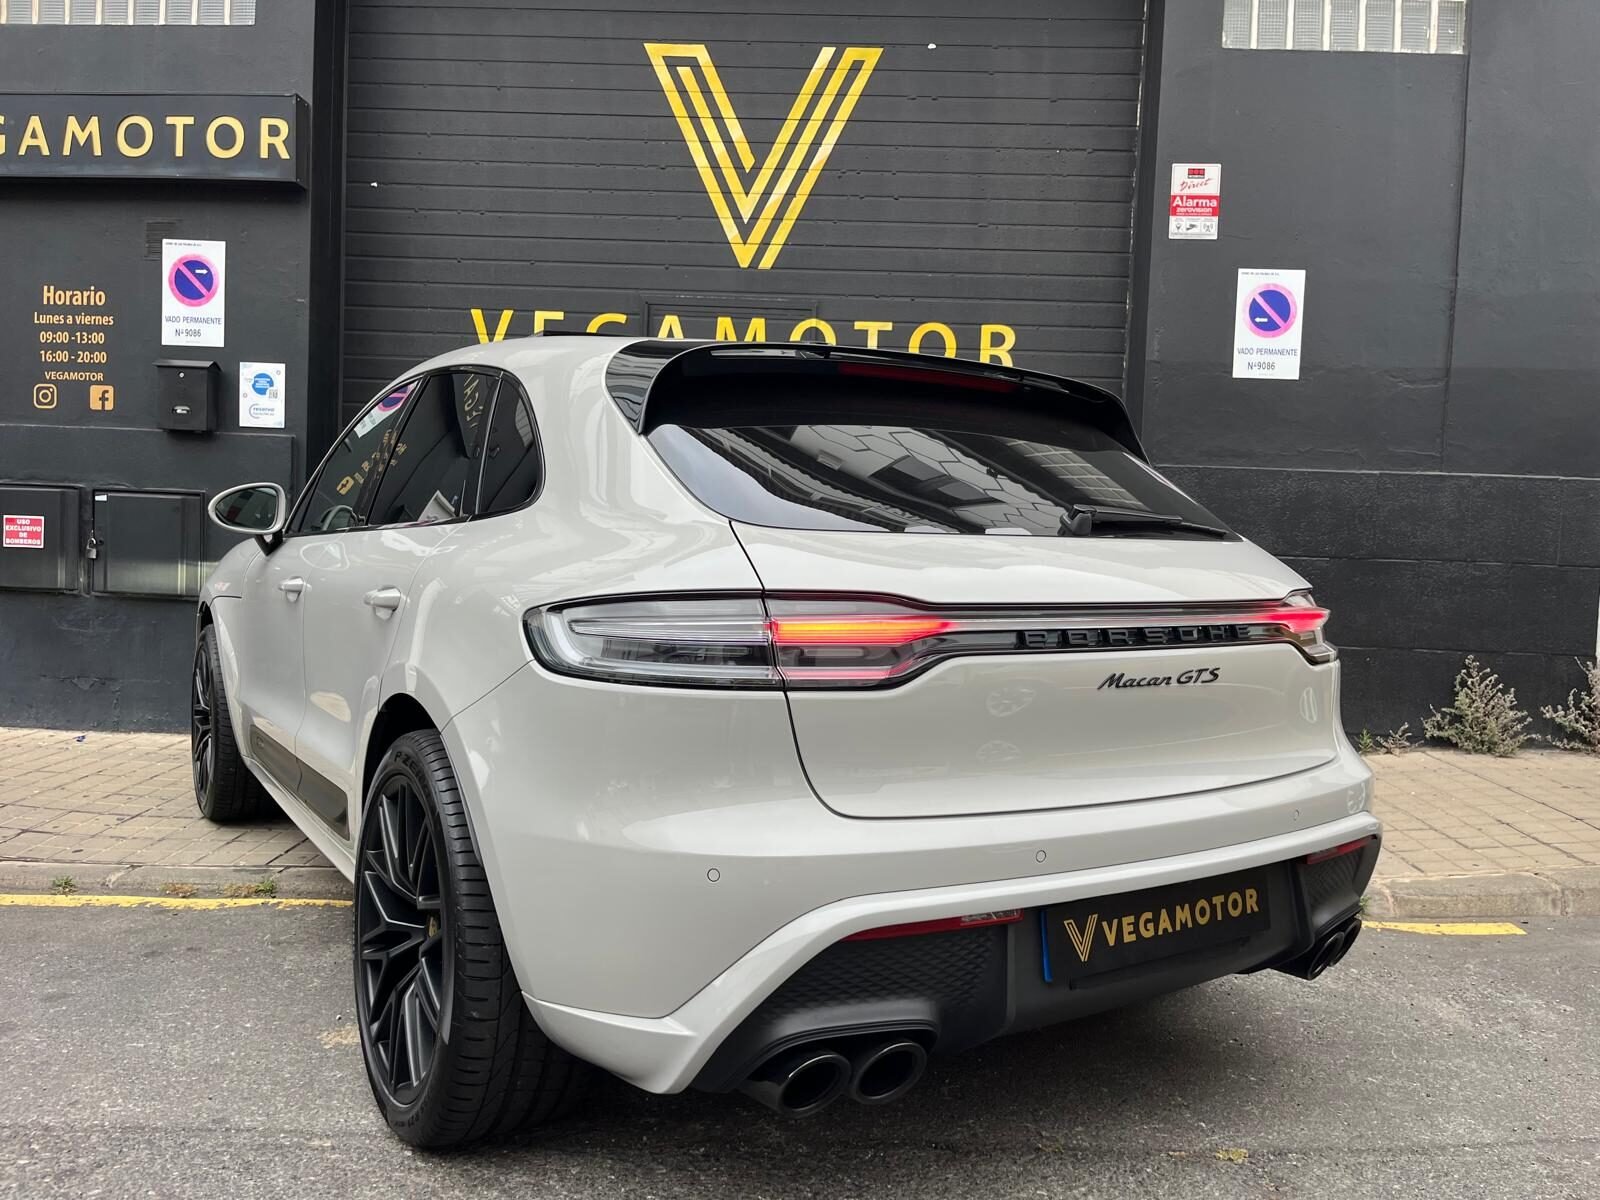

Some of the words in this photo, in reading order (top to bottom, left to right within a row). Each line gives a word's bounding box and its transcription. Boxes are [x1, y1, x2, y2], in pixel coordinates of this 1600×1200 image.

[0, 114, 290, 160] AMOTOR
[1173, 195, 1217, 207] Alarma
[43, 285, 106, 306] Horario
[34, 311, 65, 324] Lunes
[66, 315, 73, 325] a
[75, 312, 114, 325] viernes
[165, 315, 181, 324] VADO
[182, 316, 222, 325] PERMANENTE
[40, 331, 69, 344] 09:00
[40, 350, 69, 362] 16:00
[77, 351, 107, 364] 20:00
[1237, 346, 1254, 355] VADO
[1256, 346, 1298, 357] PERMANENTE
[44, 371, 104, 382] VEGAMOTOR
[1097, 672, 1172, 691] Macan
[1176, 667, 1221, 685] GTS
[1101, 888, 1260, 947] VEGAMOTOR
